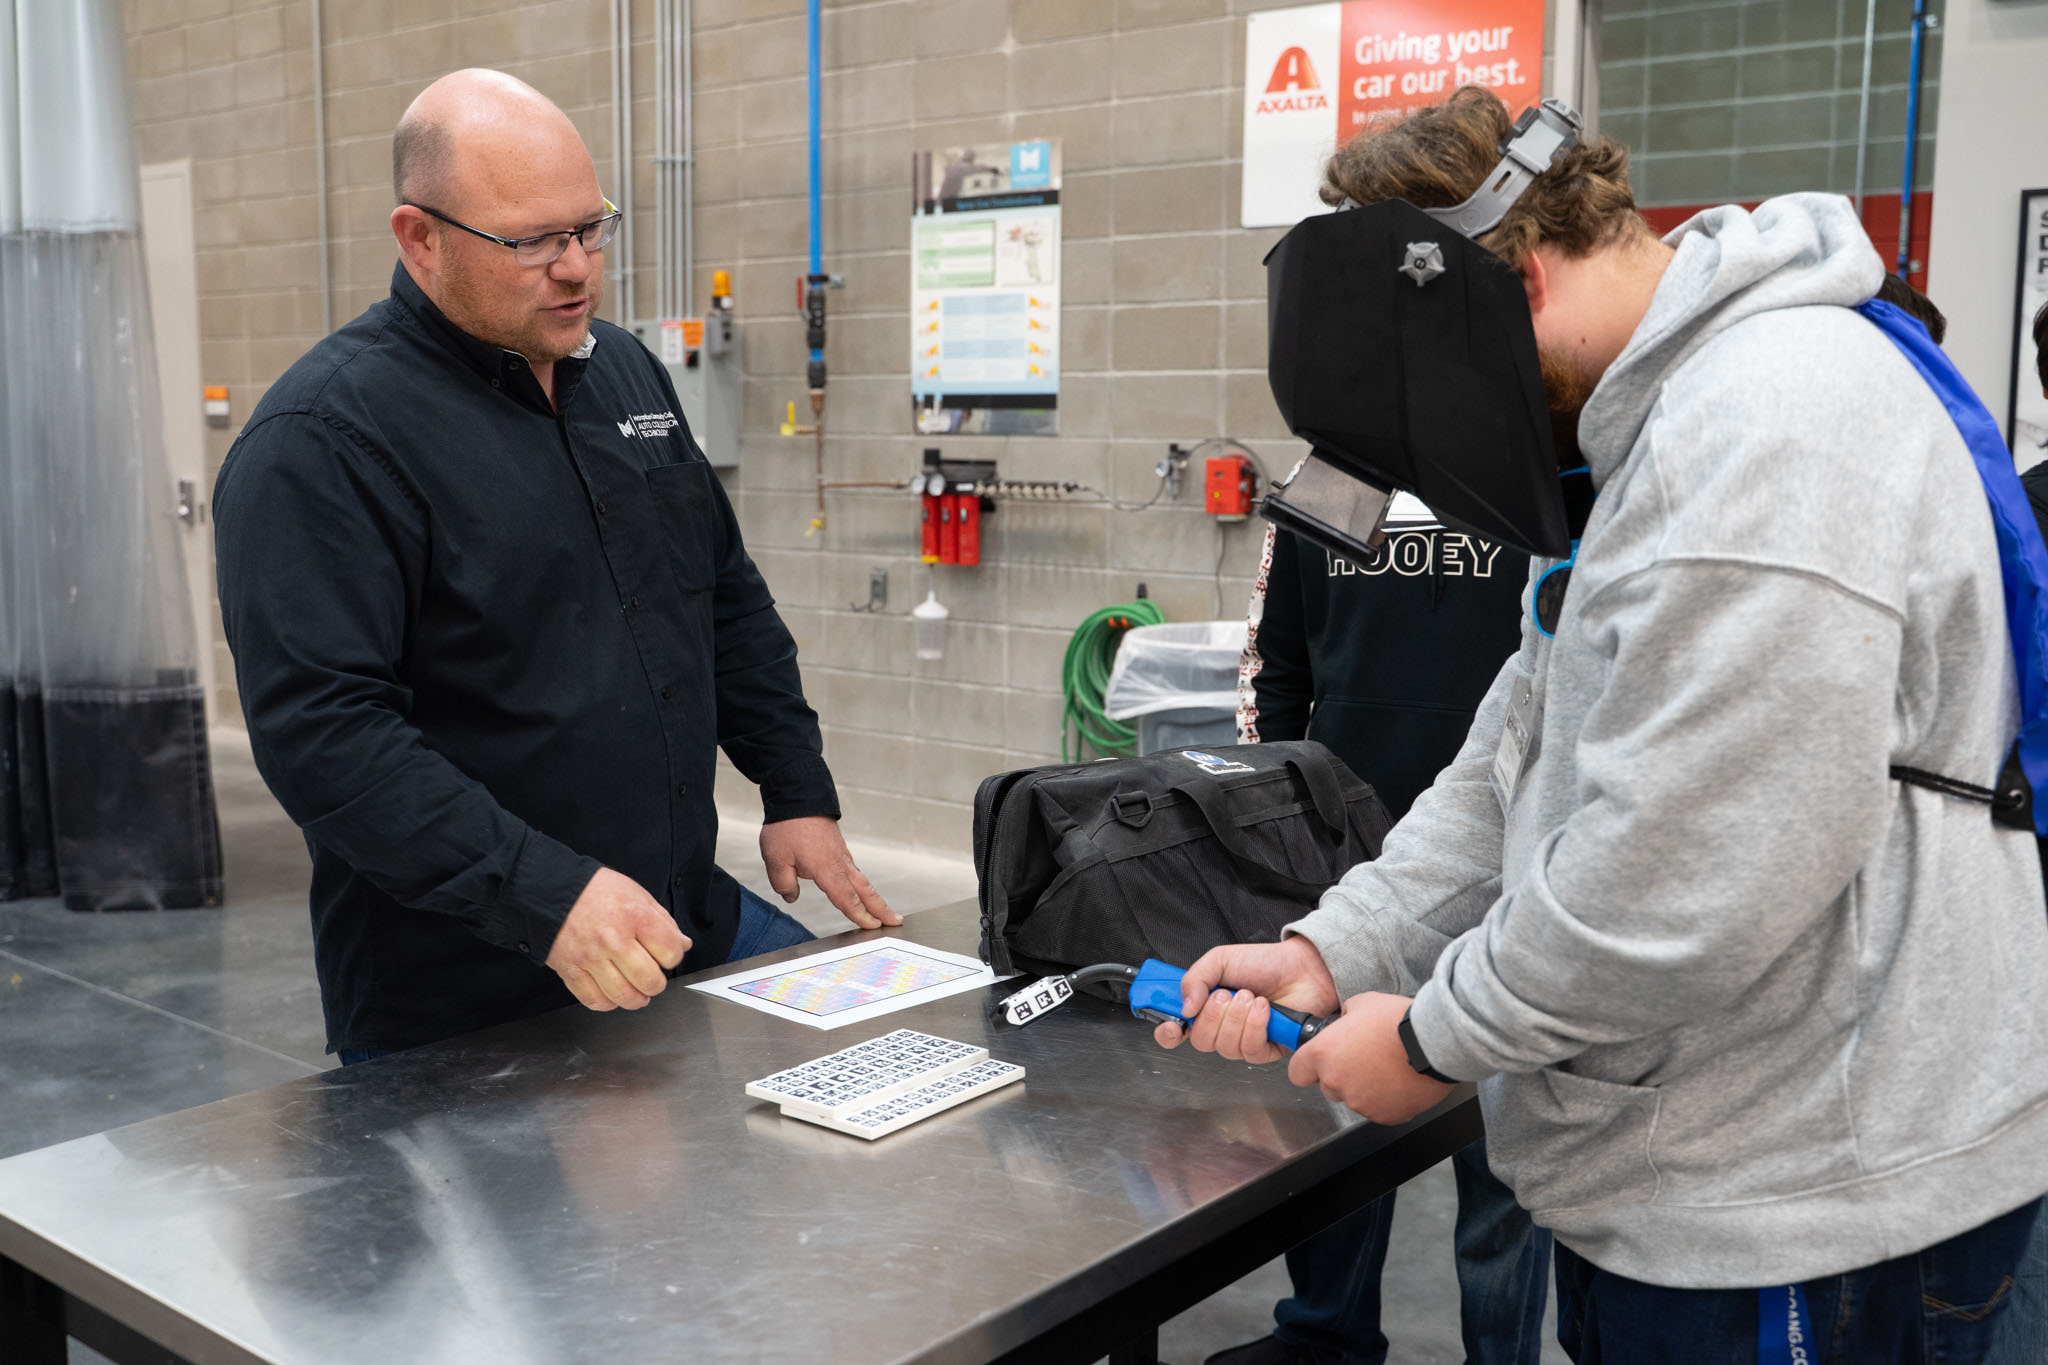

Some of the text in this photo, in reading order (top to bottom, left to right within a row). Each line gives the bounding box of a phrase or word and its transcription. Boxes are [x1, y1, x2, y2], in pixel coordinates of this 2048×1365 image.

[1355, 26, 1514, 65] Giving your
[1353, 58, 1526, 100] car our best.
[1257, 96, 1329, 115] AXALTA
